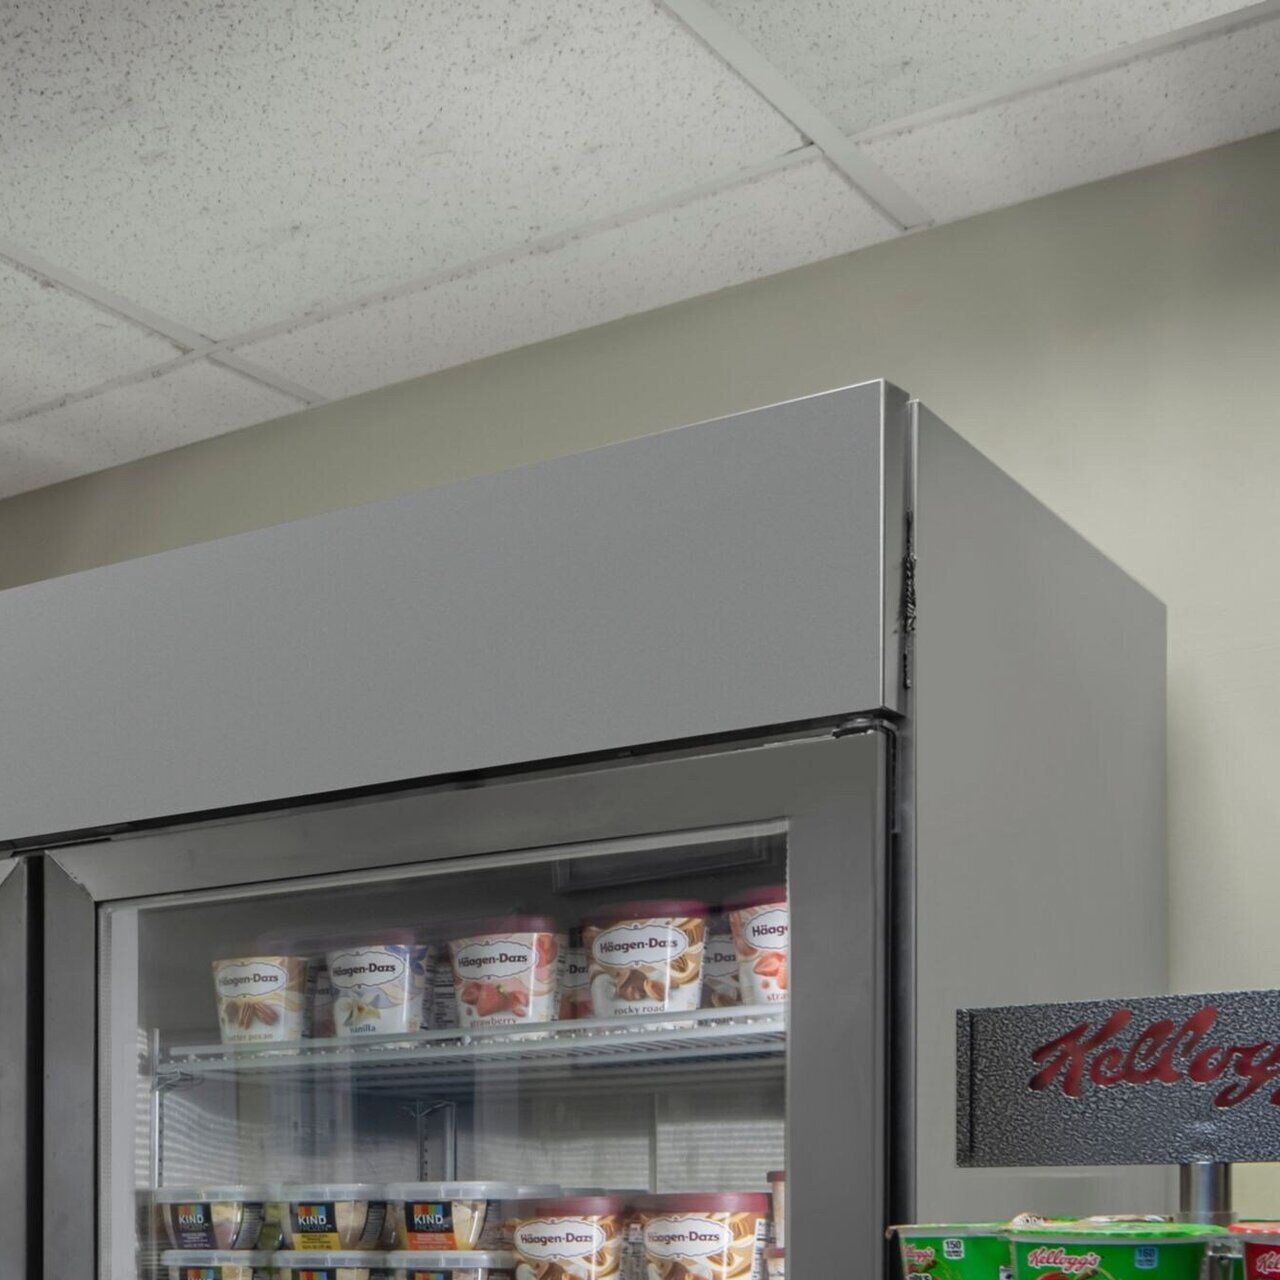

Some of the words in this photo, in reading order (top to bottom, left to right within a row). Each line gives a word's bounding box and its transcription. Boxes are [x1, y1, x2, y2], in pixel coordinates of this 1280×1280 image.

[600, 937, 678, 953] Häagen-Dazs
[642, 1004, 665, 1013] road
[179, 1214, 205, 1225] KIND
[298, 1215, 327, 1226] KIND
[414, 1214, 443, 1225] KIND
[521, 1232, 593, 1246] Häagen-Dazs
[945, 1241, 961, 1250] 150
[1028, 1247, 1100, 1272] Kellogg's
